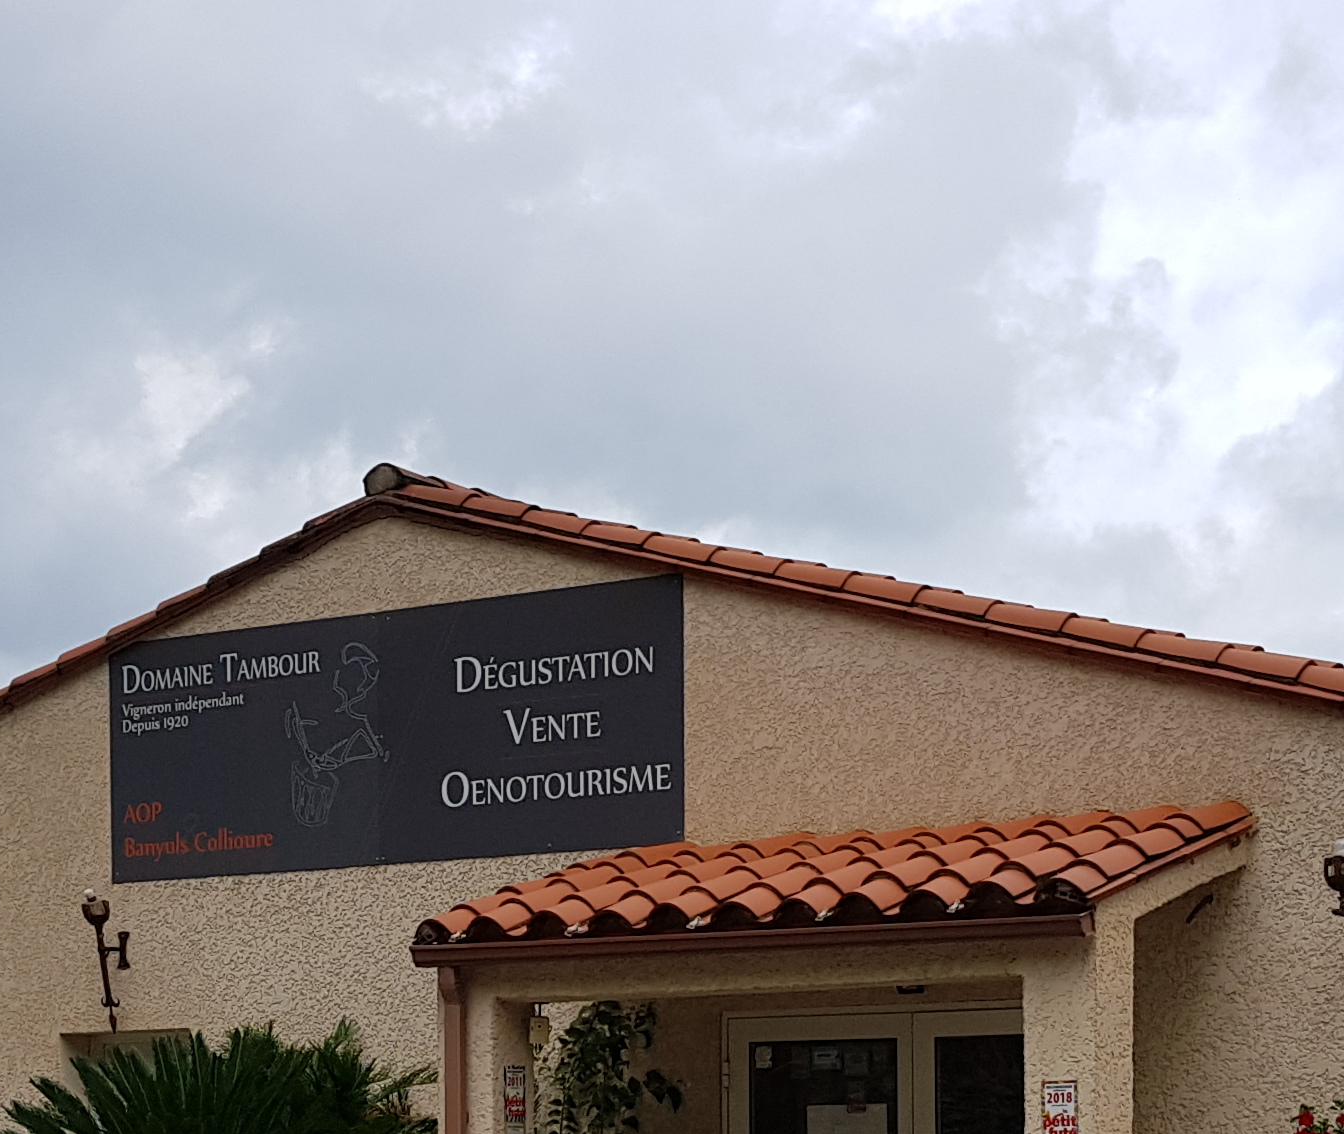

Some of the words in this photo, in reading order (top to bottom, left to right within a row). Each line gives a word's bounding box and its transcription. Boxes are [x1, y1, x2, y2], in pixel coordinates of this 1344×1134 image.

[121, 663, 214, 694] DOMAINE
[219, 651, 321, 683] TAMBOUR
[453, 646, 654, 693] DÉGUSTATION
[121, 702, 172, 720] Vigneron
[174, 691, 244, 713] indépendant
[122, 717, 161, 736] Depuis
[163, 715, 189, 731] 1920
[502, 707, 602, 745] VENTE
[440, 763, 673, 808] OENOTOURISME
[123, 801, 164, 824] AOP
[123, 831, 190, 862] Banyuls
[193, 827, 275, 853] Collioure
[1046, 1092, 1073, 1104] 2018
